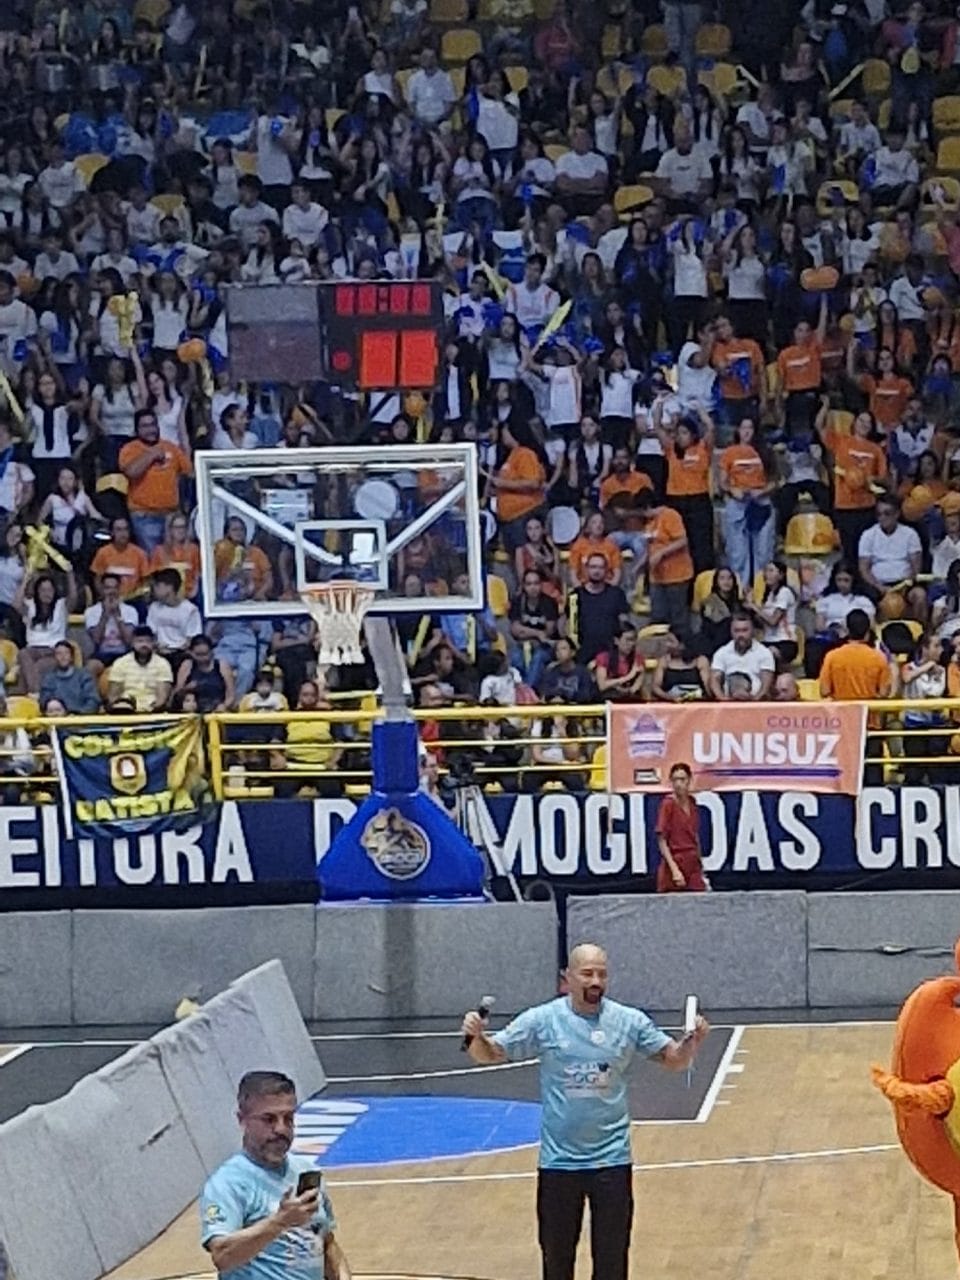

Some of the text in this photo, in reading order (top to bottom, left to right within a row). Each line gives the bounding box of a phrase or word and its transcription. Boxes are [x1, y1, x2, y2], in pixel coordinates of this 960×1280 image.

[693, 731, 841, 765] UNISUZ
[467, 793, 648, 876] MOGI
[696, 790, 821, 871] DAS
